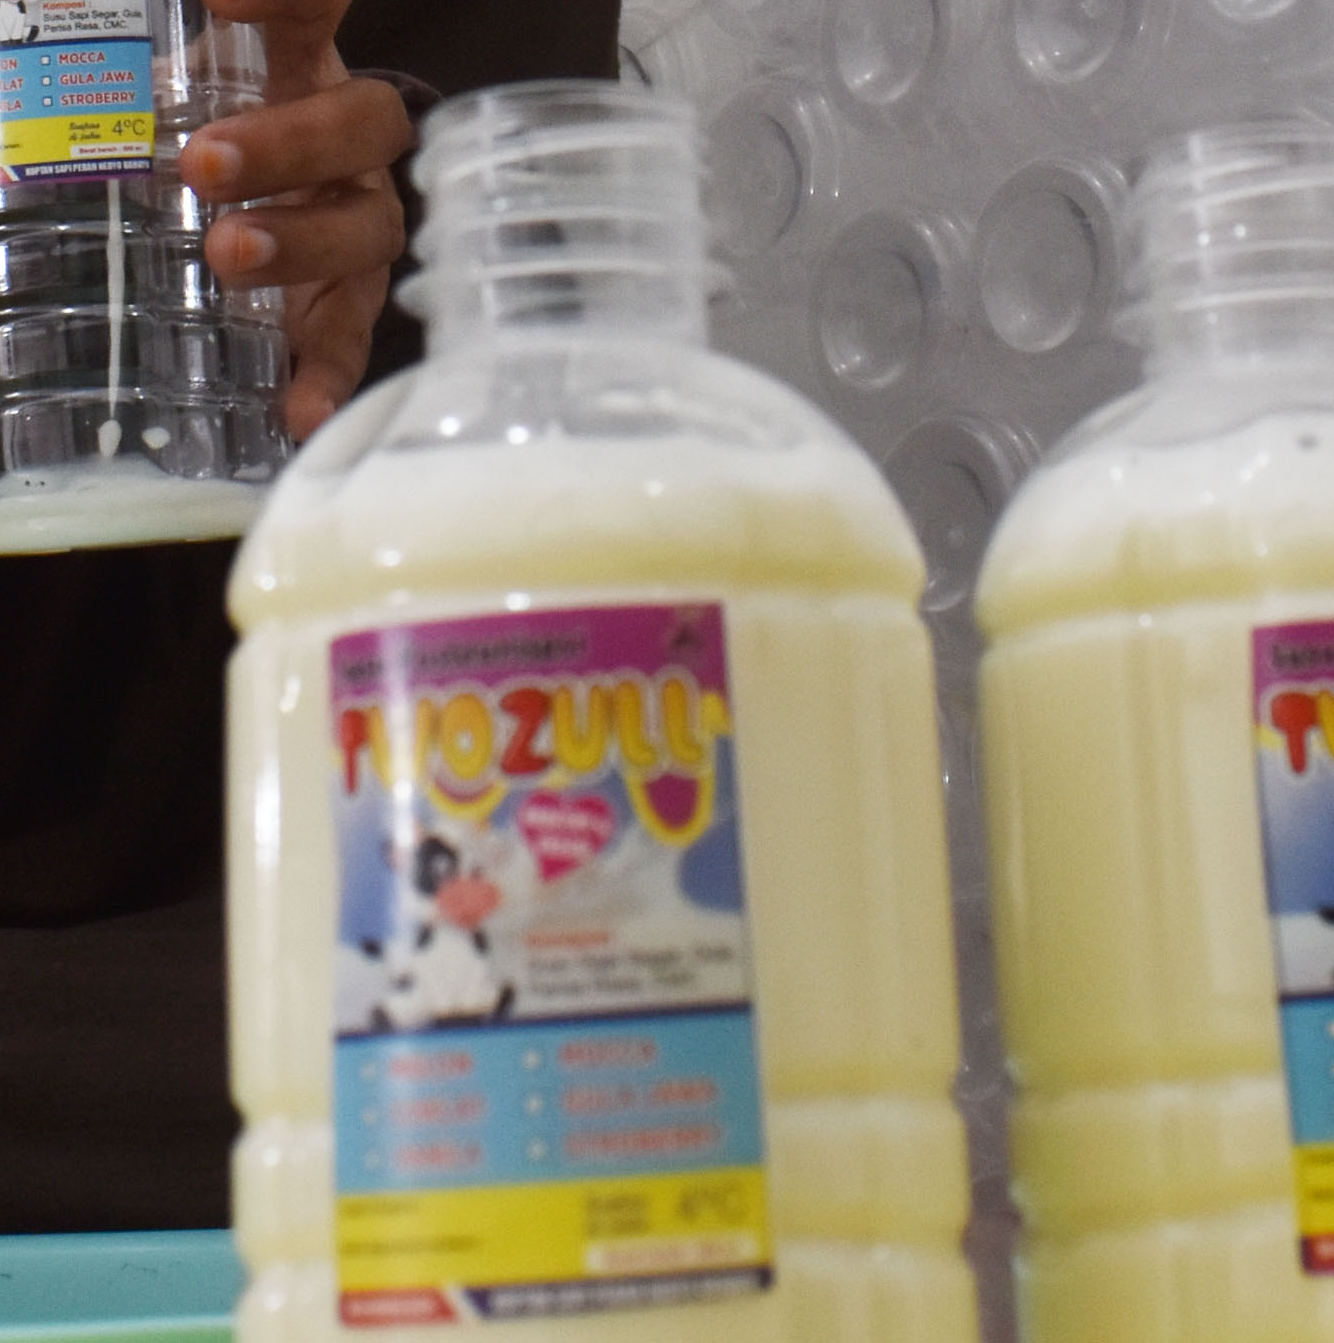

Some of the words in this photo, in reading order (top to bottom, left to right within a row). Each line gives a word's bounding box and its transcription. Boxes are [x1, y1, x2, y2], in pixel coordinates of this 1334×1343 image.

[58, 52, 106, 65] MOCCA
[60, 73, 95, 85] GULA
[99, 71, 135, 84] JAWA
[61, 91, 136, 106] STROBERRY
